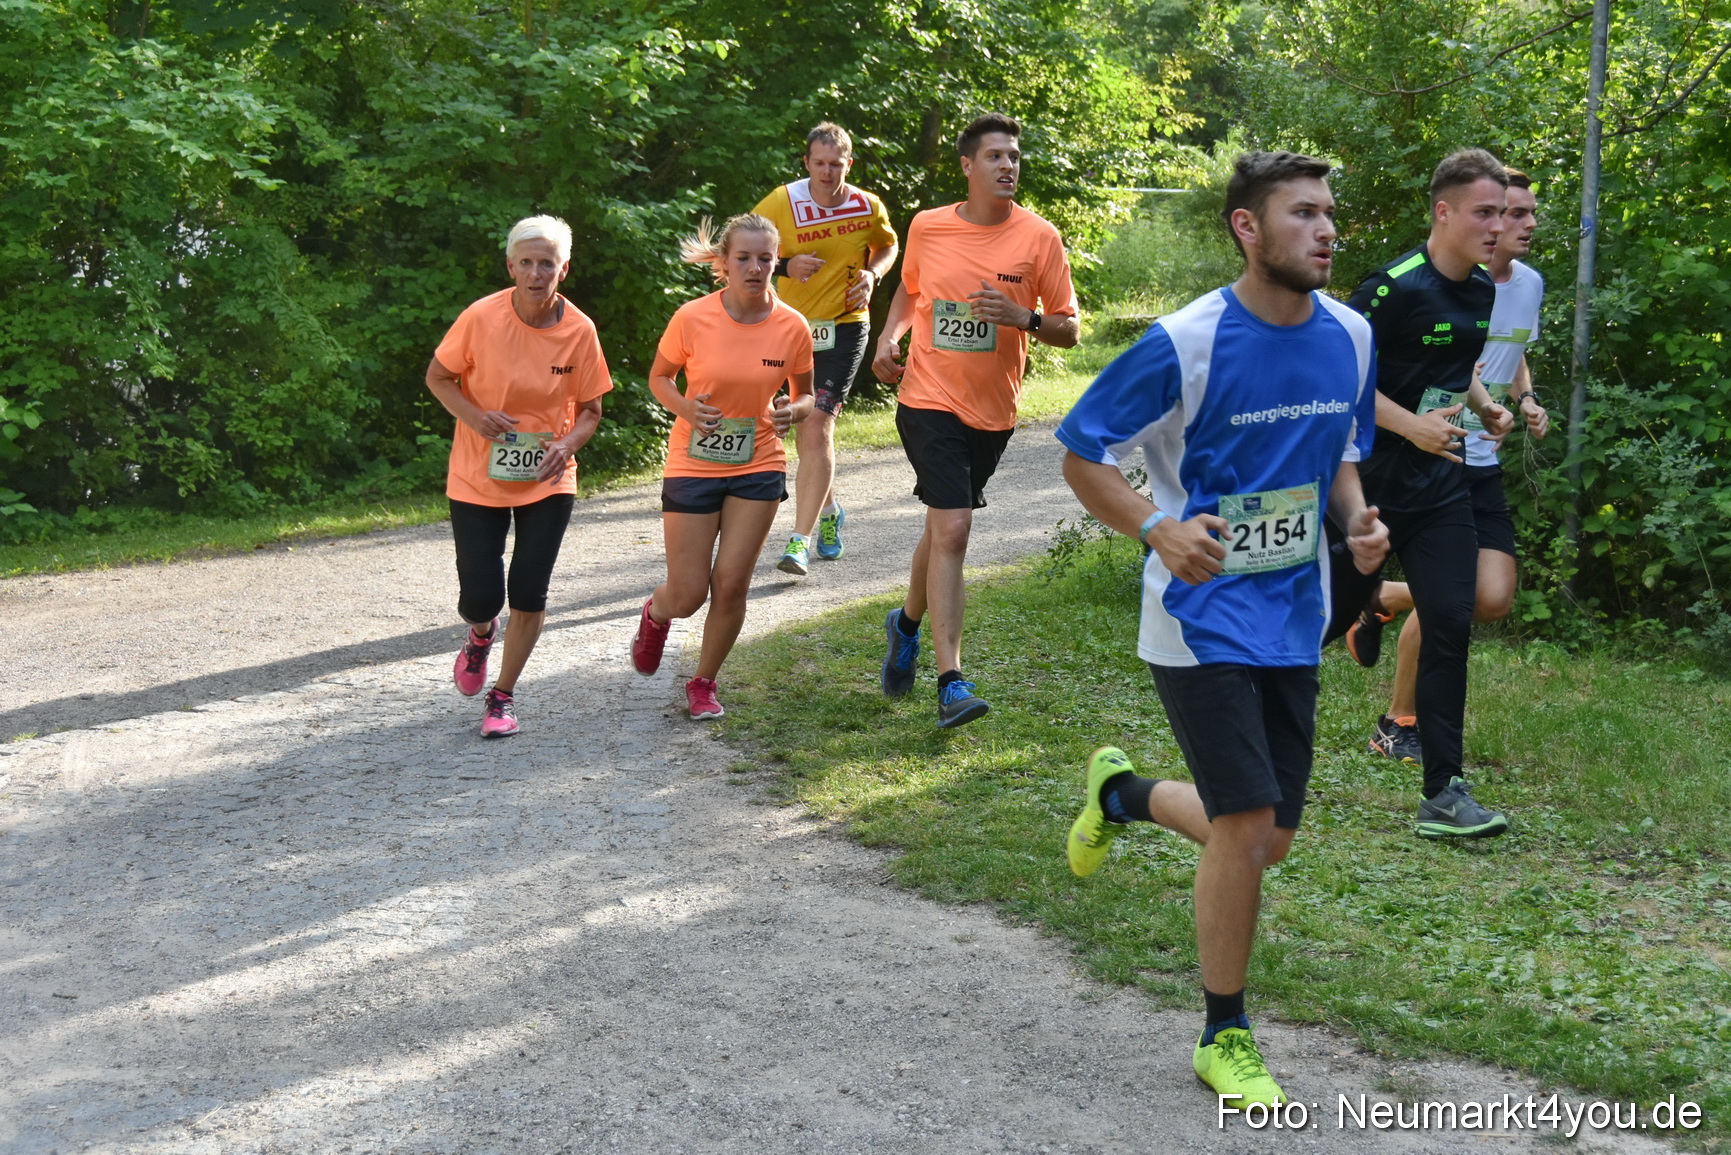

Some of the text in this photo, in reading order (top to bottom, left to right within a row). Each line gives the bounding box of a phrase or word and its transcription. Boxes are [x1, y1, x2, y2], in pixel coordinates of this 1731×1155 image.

[797, 228, 832, 243] MAX
[996, 273, 1022, 283] THULE
[938, 318, 988, 338] 2290
[1434, 323, 1451, 332] JAKO
[762, 359, 785, 368] THULE
[1230, 399, 1349, 425] energiegeladen
[697, 434, 747, 452] 2287
[1232, 514, 1307, 552] 2154
[1248, 546, 1296, 559] Nutz Bastian
